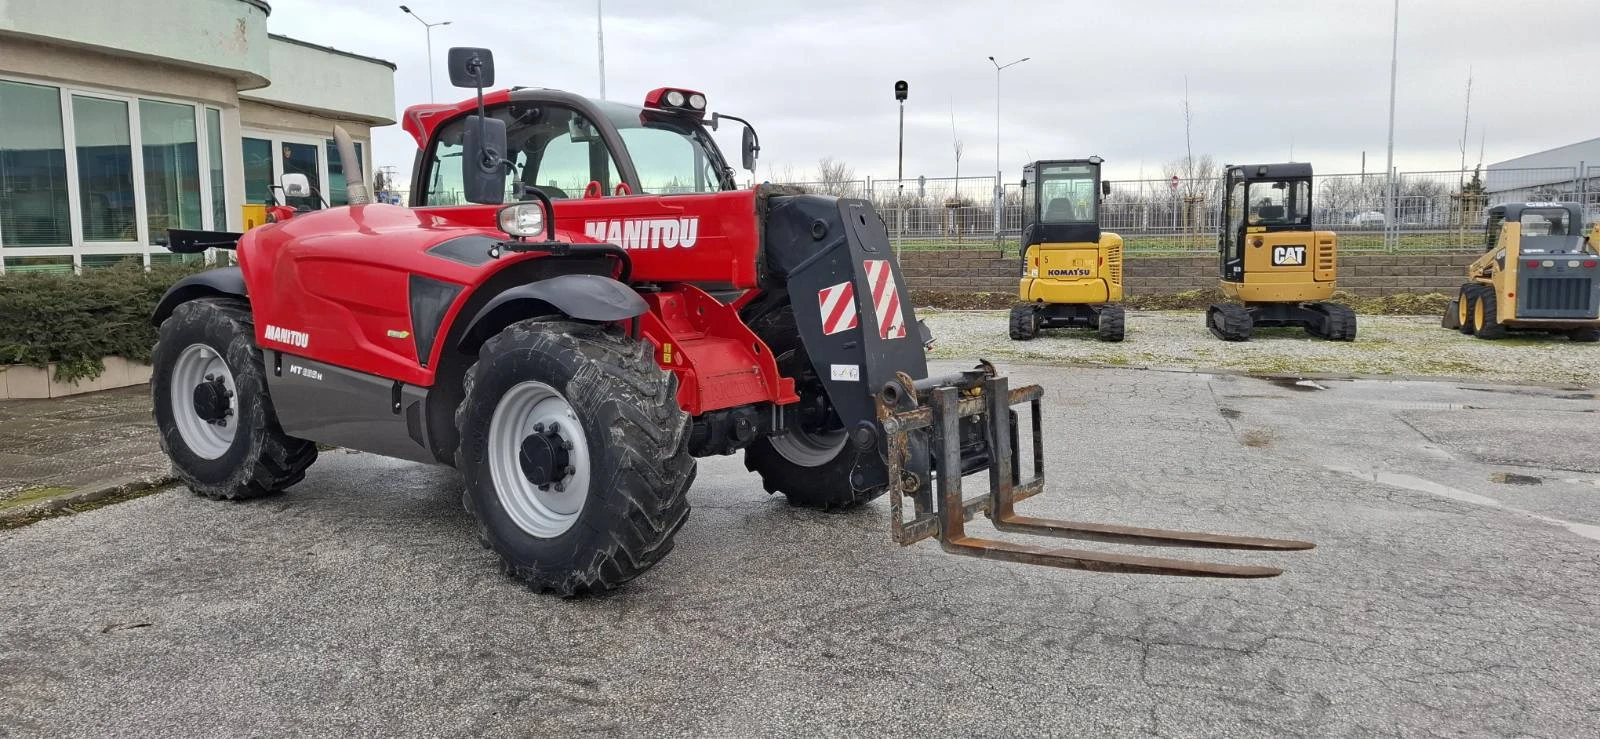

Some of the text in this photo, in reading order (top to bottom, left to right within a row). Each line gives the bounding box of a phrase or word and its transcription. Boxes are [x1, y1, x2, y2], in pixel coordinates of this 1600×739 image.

[585, 217, 699, 249] MANITOU
[1274, 247, 1305, 264] CAT
[1047, 268, 1090, 276] KOMATSU
[264, 324, 309, 349] MANITOU
